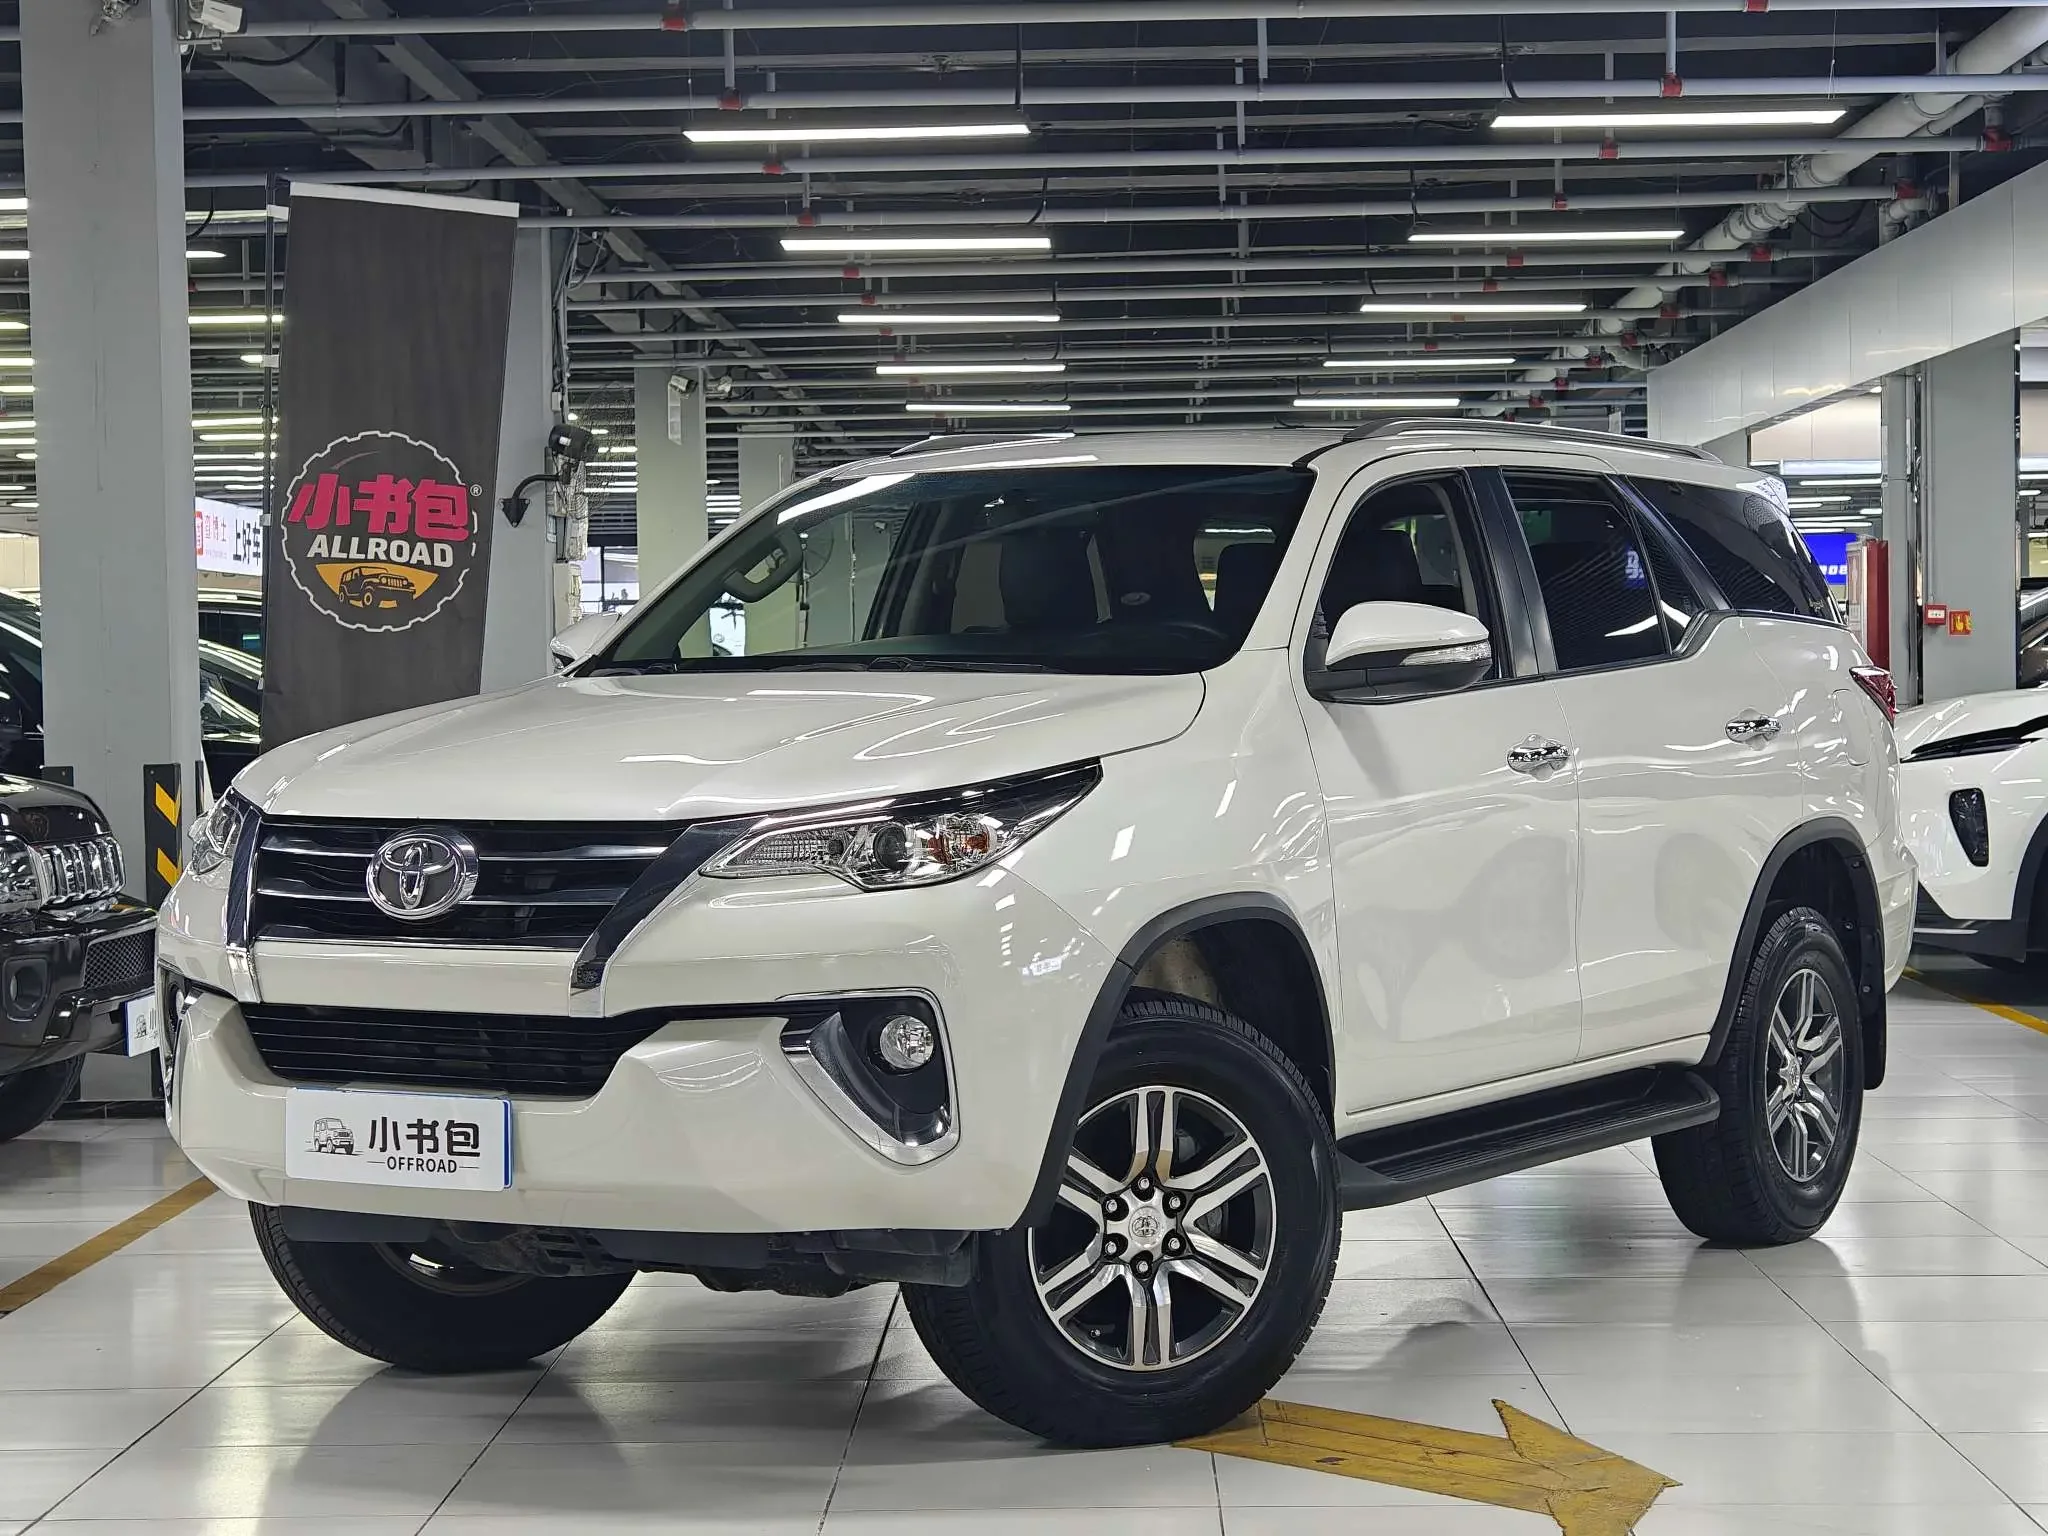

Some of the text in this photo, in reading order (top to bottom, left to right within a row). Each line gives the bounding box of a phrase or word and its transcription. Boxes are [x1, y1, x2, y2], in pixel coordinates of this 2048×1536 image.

[288, 473, 469, 541] 小书包
[306, 534, 454, 568] ALLROAD
[368, 1116, 481, 1158] 小书包
[386, 1156, 458, 1174] OFFROAD
